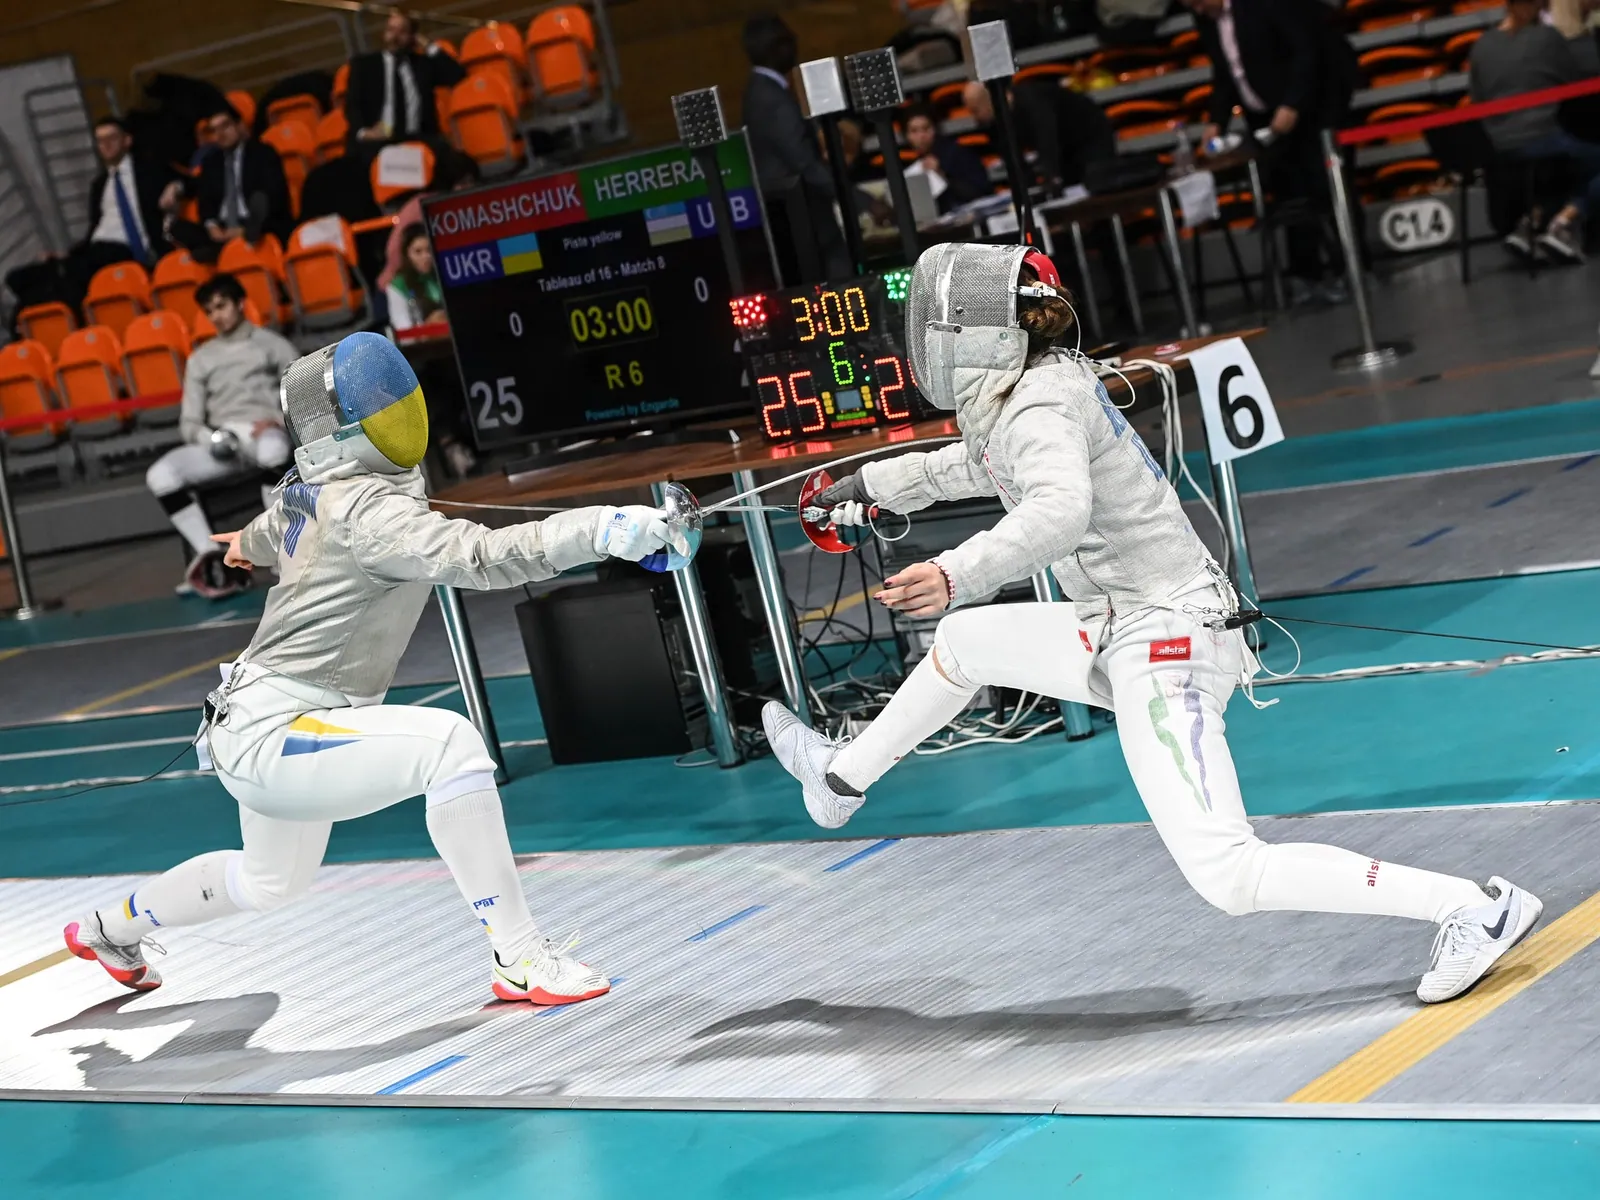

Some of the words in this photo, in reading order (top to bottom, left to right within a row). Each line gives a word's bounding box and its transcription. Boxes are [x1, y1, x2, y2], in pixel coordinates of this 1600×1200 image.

[594, 156, 705, 201] HERRERA
[429, 183, 581, 236] KOMASHCHUK
[696, 195, 750, 229] UB
[1388, 208, 1444, 243] C1.4
[563, 236, 587, 250] Piste
[589, 230, 622, 248] yellow
[445, 248, 496, 280] UKR
[538, 274, 582, 292] Tableau
[584, 268, 596, 283] of
[598, 265, 612, 280] 16
[620, 257, 656, 277] Match
[694, 276, 709, 302] 0
[509, 311, 523, 337] 0
[570, 297, 653, 342] 03:00
[791, 286, 870, 342] 3:00
[605, 364, 624, 390] R
[629, 360, 644, 386] 6
[828, 340, 855, 386] 6
[470, 376, 524, 430] 25
[757, 370, 826, 438] 25
[873, 355, 919, 420] 2
[1218, 364, 1265, 450] 6
